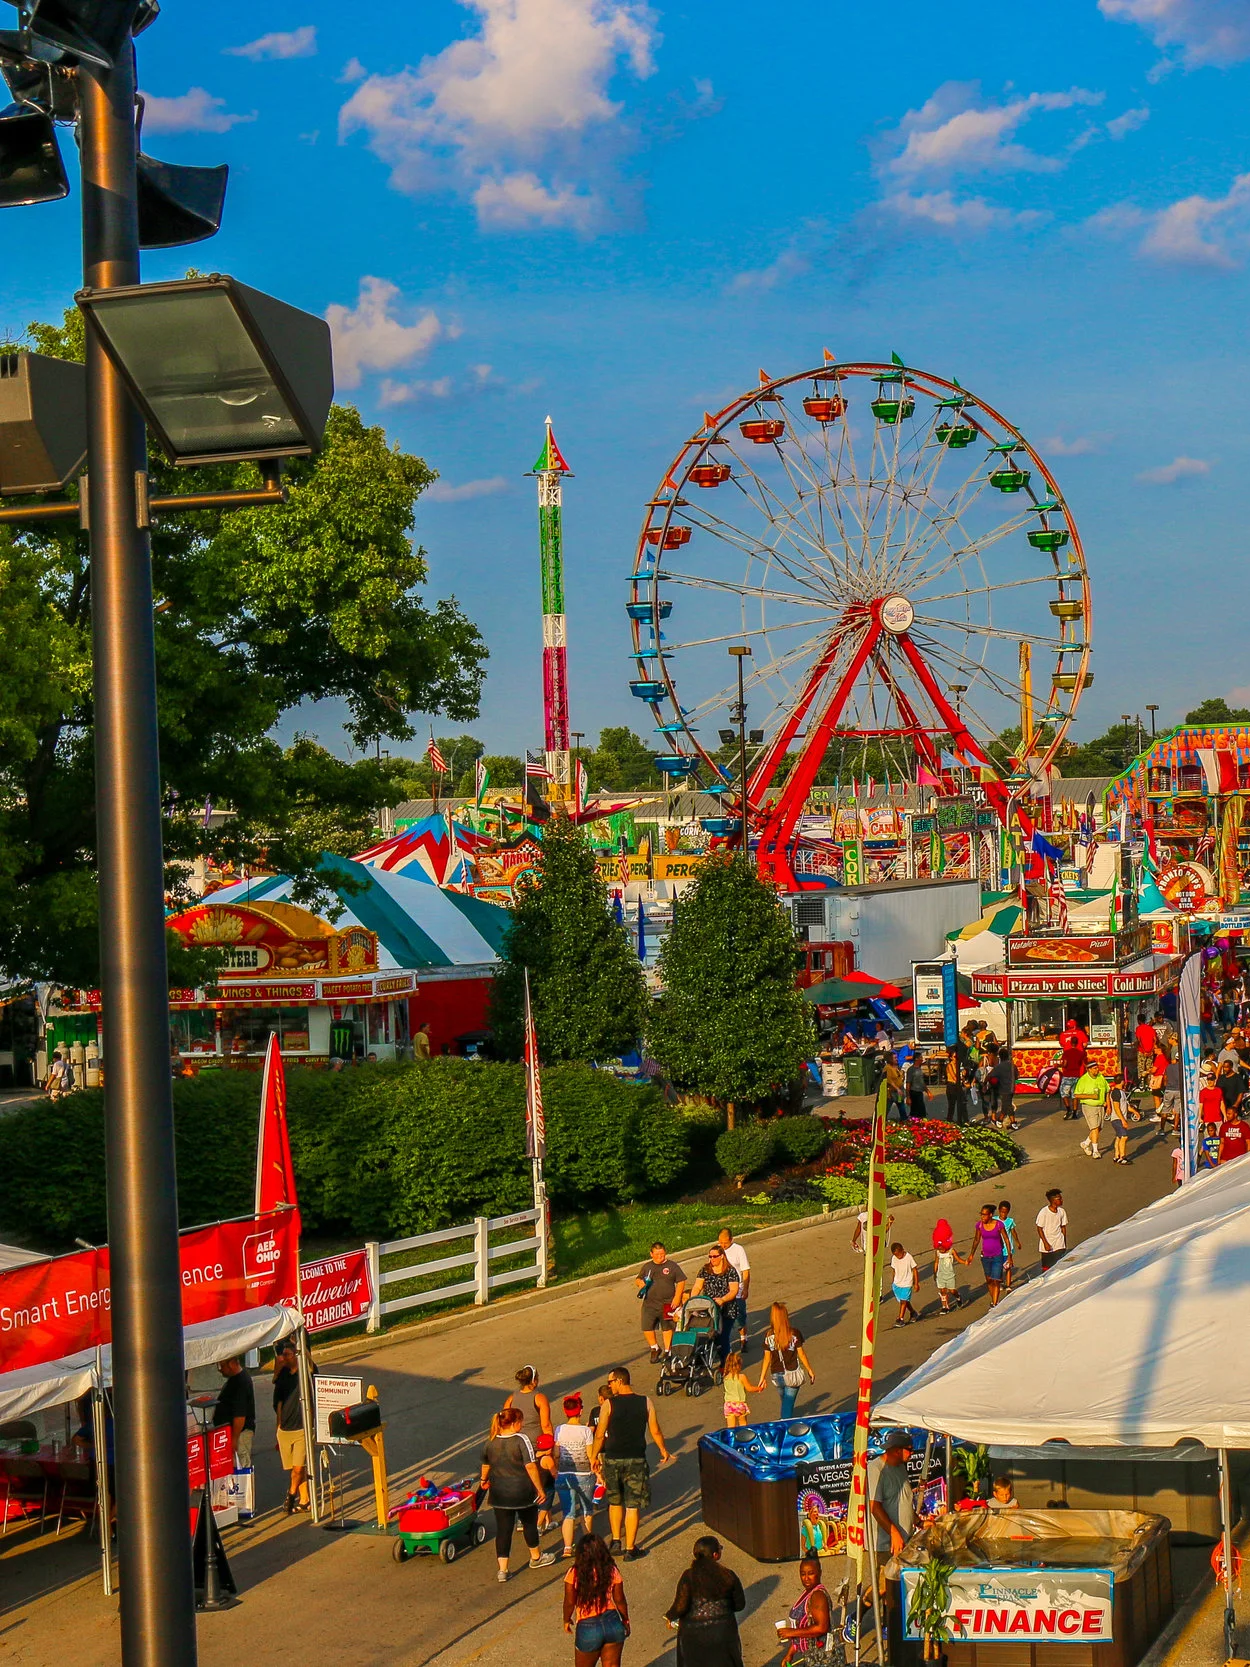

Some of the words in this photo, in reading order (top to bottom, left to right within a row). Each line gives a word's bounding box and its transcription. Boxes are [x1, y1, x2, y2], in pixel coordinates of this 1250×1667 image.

[1177, 733, 1228, 750] KING'S
[503, 852, 542, 869] HARV
[845, 849, 858, 886] COR
[630, 863, 649, 875] PERC
[666, 863, 698, 877] PERC
[1061, 870, 1079, 881] CKETS
[1158, 867, 1184, 892] PRONTO
[1184, 869, 1202, 890] POPS
[1089, 938, 1111, 949] Pizza!
[222, 949, 259, 968] STERS
[255, 988, 263, 998] &
[265, 986, 303, 998] THINGS
[323, 985, 341, 995] SWEET
[343, 984, 359, 994] POTATO
[378, 979, 395, 992] CURLY
[977, 978, 1003, 993] Drinks
[1011, 982, 1040, 992] Pizza
[1042, 982, 1054, 993] by
[1057, 980, 1075, 991] the
[1077, 979, 1107, 991] Slice!
[1114, 978, 1135, 992] Cold
[1136, 977, 1156, 991] Drin
[256, 1240, 277, 1253] AEP
[255, 1249, 281, 1265] OHIO
[300, 1266, 325, 1281] ELCOME
[324, 1263, 334, 1275] TO
[333, 1259, 347, 1272] THE
[251, 1281, 260, 1289] AEP
[1, 1296, 61, 1332] Smart
[66, 1286, 112, 1316] Energ
[303, 1312, 314, 1328] ER
[315, 1300, 353, 1326] GARDEN
[317, 1387, 350, 1395] COMMUNITY
[802, 1473, 819, 1485] LAS
[820, 1470, 850, 1482] VEGAS
[906, 1458, 942, 1471] FLODA
[818, 1464, 835, 1472] RECEIVE
[977, 1583, 1037, 1598] PINNACLE
[953, 1608, 1104, 1635] FINANCE
